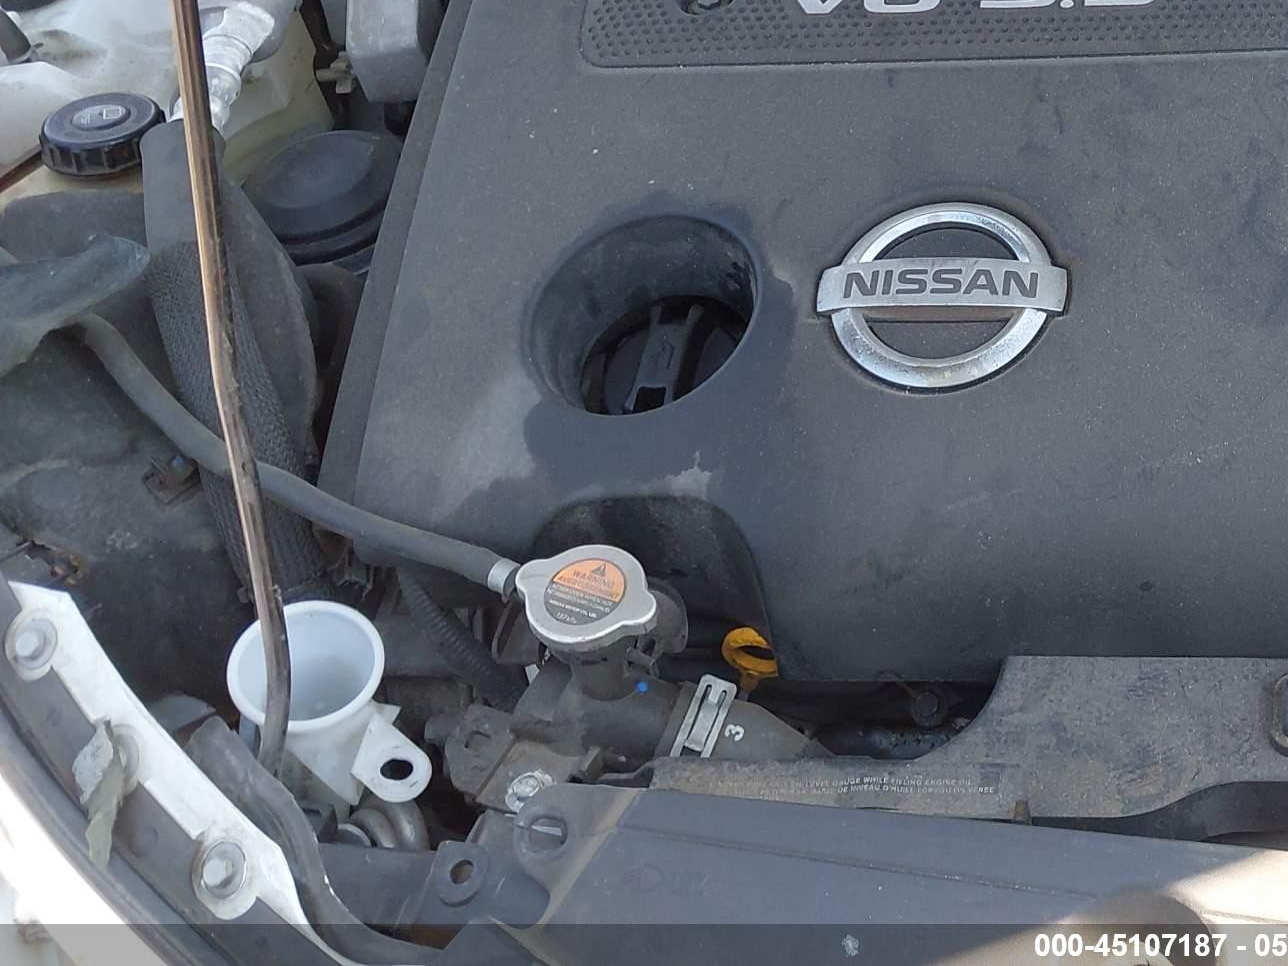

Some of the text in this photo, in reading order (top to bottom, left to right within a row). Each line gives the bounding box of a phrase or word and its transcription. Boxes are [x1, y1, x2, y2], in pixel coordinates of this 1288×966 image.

[843, 268, 1039, 299] NISSAN
[724, 724, 745, 742] 3
[863, 776, 889, 784] WHILE
[850, 784, 880, 793] NIVEAU
